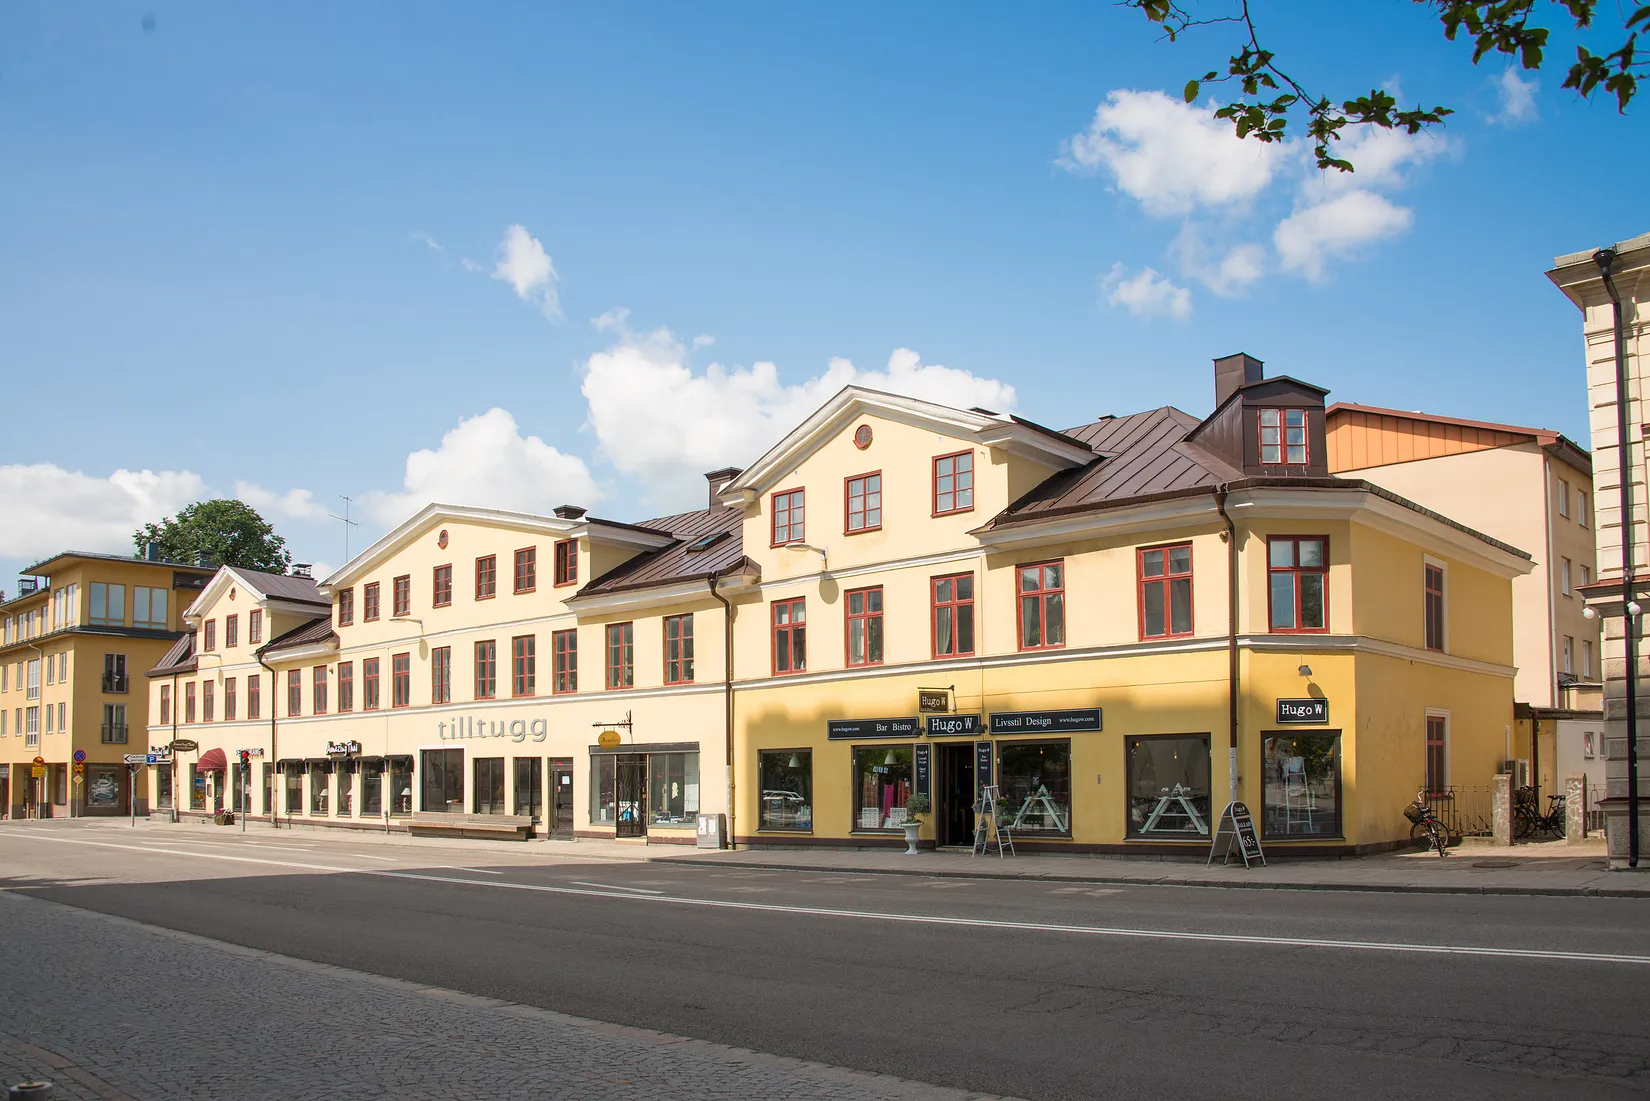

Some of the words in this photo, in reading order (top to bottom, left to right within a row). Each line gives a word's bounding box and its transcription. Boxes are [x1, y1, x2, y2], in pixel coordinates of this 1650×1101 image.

[922, 696, 940, 707] Hugo
[941, 697, 946, 706] W
[1281, 704, 1313, 716] Hugo
[1315, 703, 1323, 714] W
[876, 723, 888, 732] Bar
[892, 722, 912, 731] Bistro
[931, 718, 963, 733] Hugo
[964, 717, 973, 729] W
[995, 718, 1022, 727] Livsstil
[1026, 716, 1052, 727] Design
[438, 716, 548, 743] tilltugg
